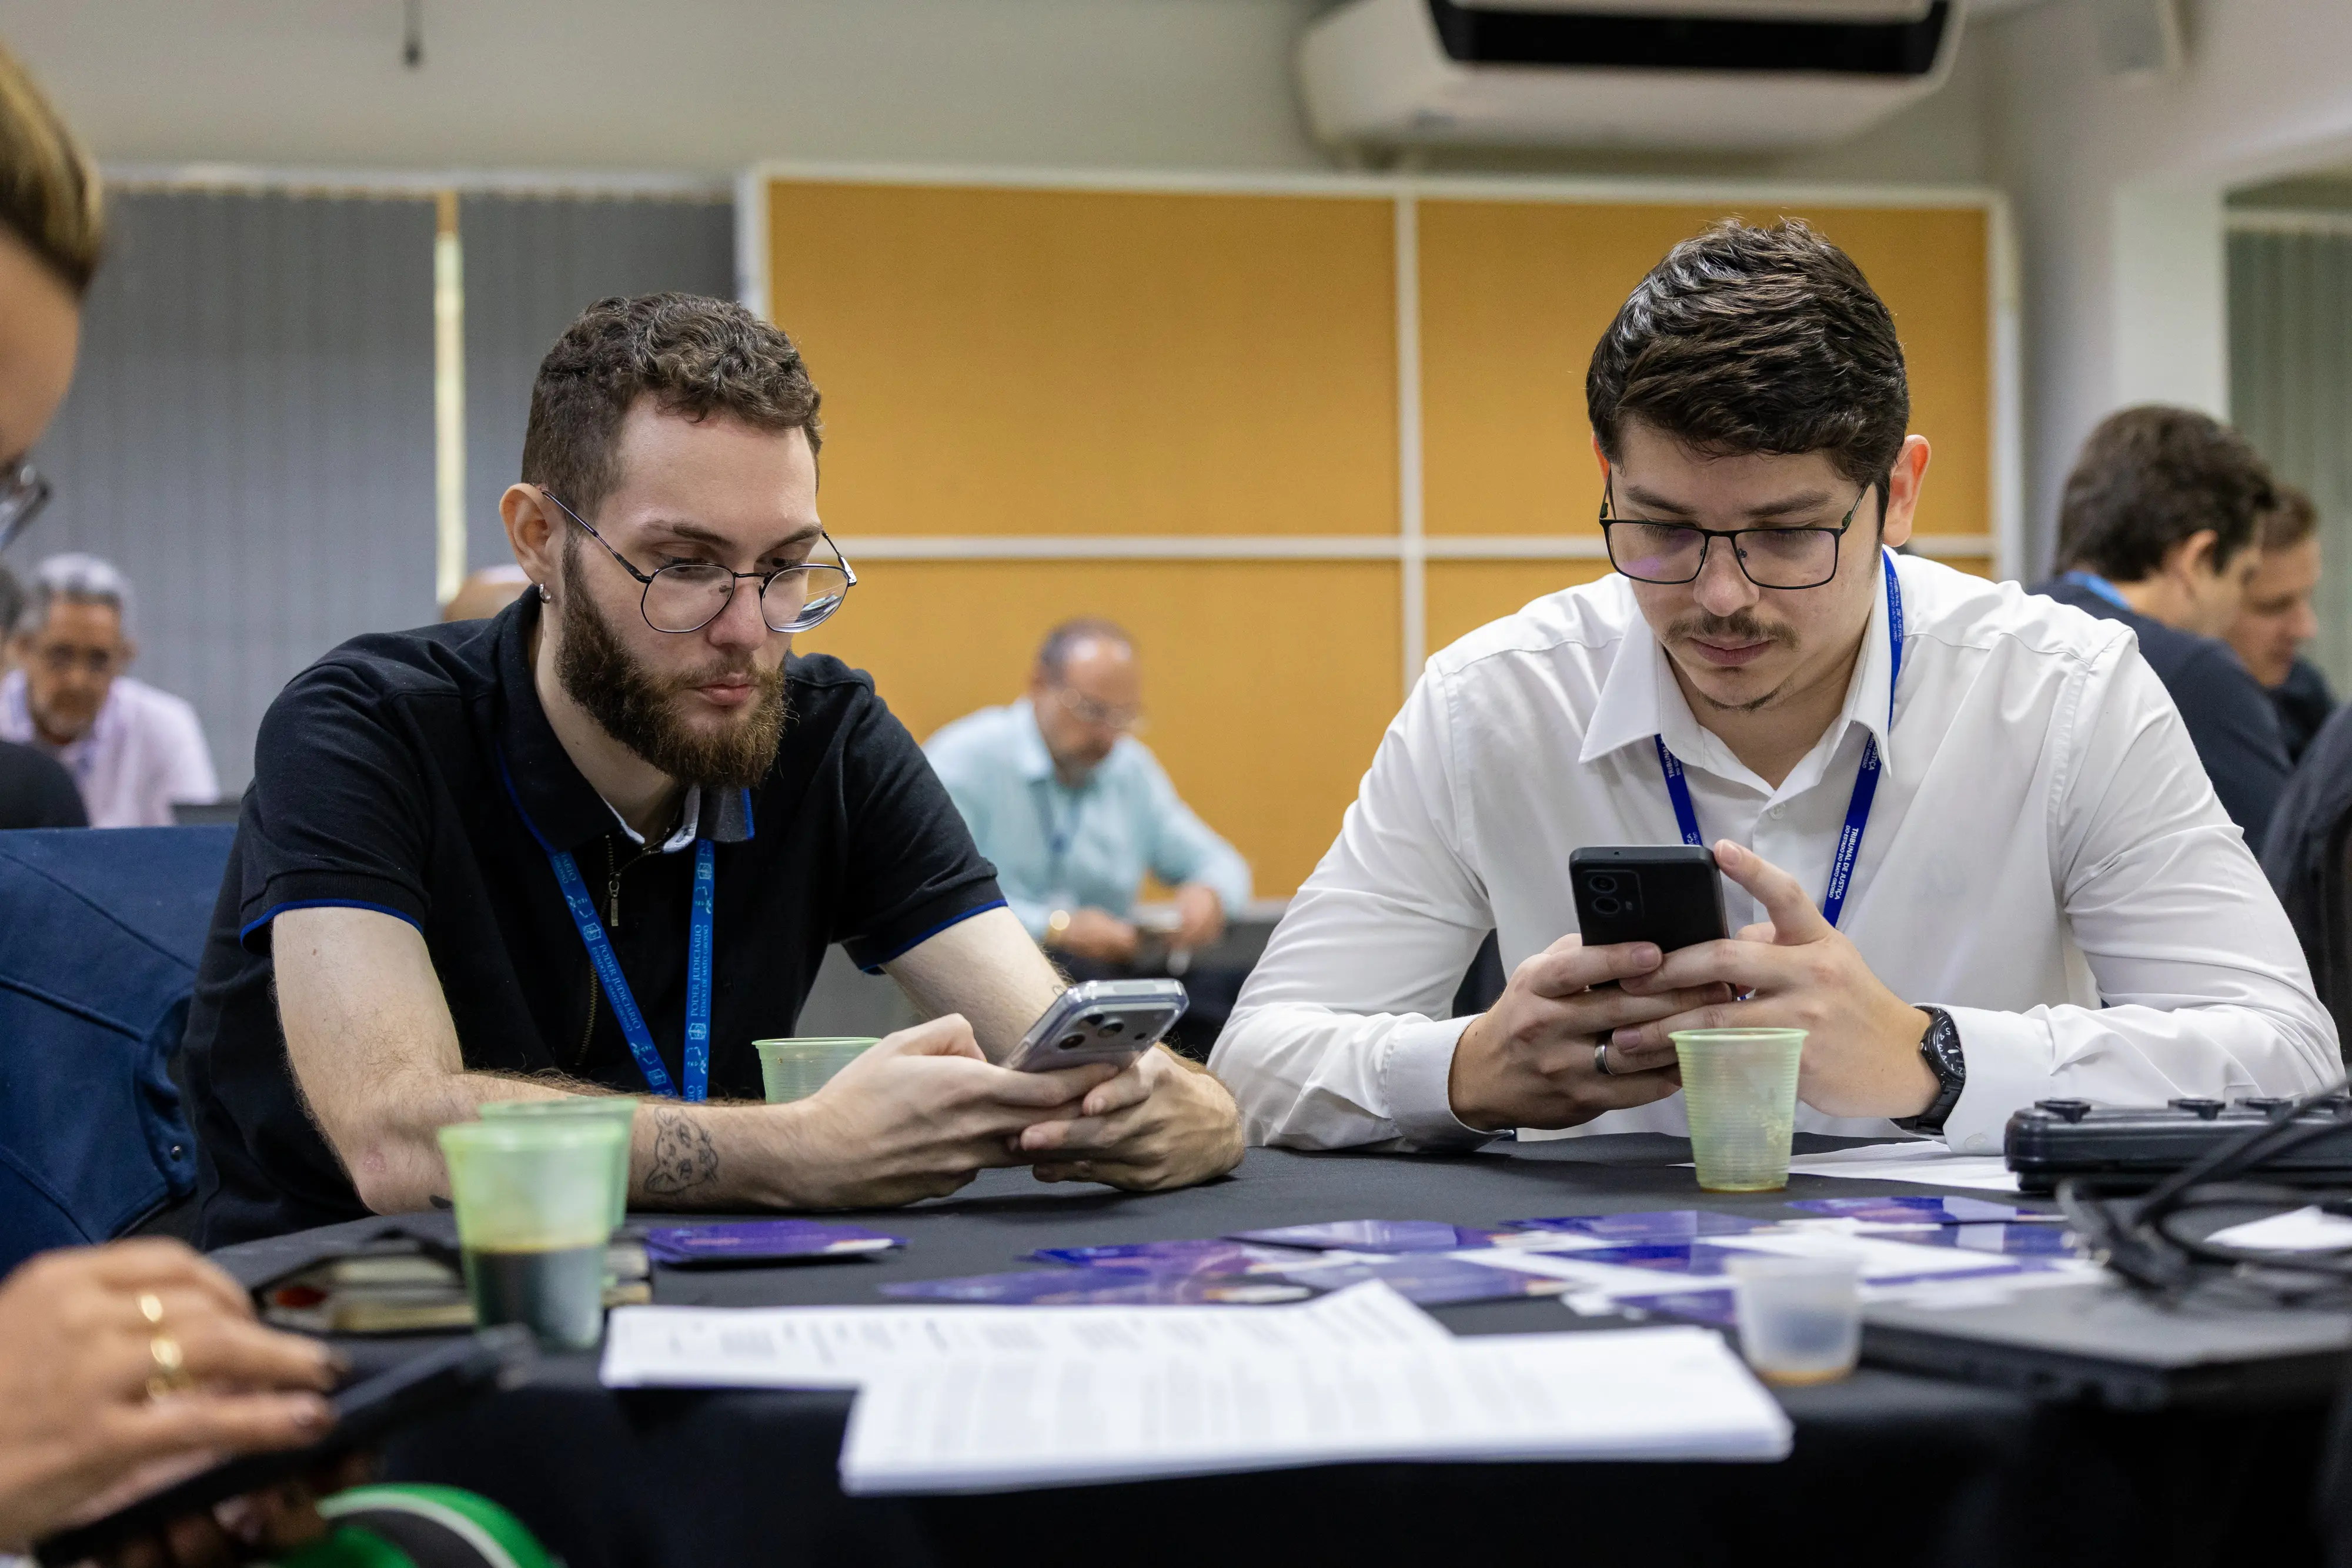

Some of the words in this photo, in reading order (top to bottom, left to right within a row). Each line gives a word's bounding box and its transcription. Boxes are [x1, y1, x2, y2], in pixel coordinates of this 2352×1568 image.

[1896, 608, 1902, 617] DE
[1845, 825, 1851, 834] DO
[1840, 834, 1849, 853] ESTADO
[1845, 828, 1859, 861] TRIBUNAL
[1838, 853, 1844, 862] DO
[1842, 862, 1850, 872] DE
[1829, 877, 1838, 898] GROSSO
[1834, 872, 1846, 900] JUSTIÇA
[693, 924, 702, 981] JUDICIÁRIO
[592, 947, 606, 973] ESTADO
[603, 974, 612, 982] DE
[608, 985, 620, 1004] MATO
[617, 1004, 633, 1032] GROSSO
[599, 944, 617, 976] PODER
[612, 977, 641, 1029] JUDICIÁRIO
[702, 978, 707, 987] DE
[691, 984, 700, 1017] PODER
[1945, 1027, 1951, 1035] 5
